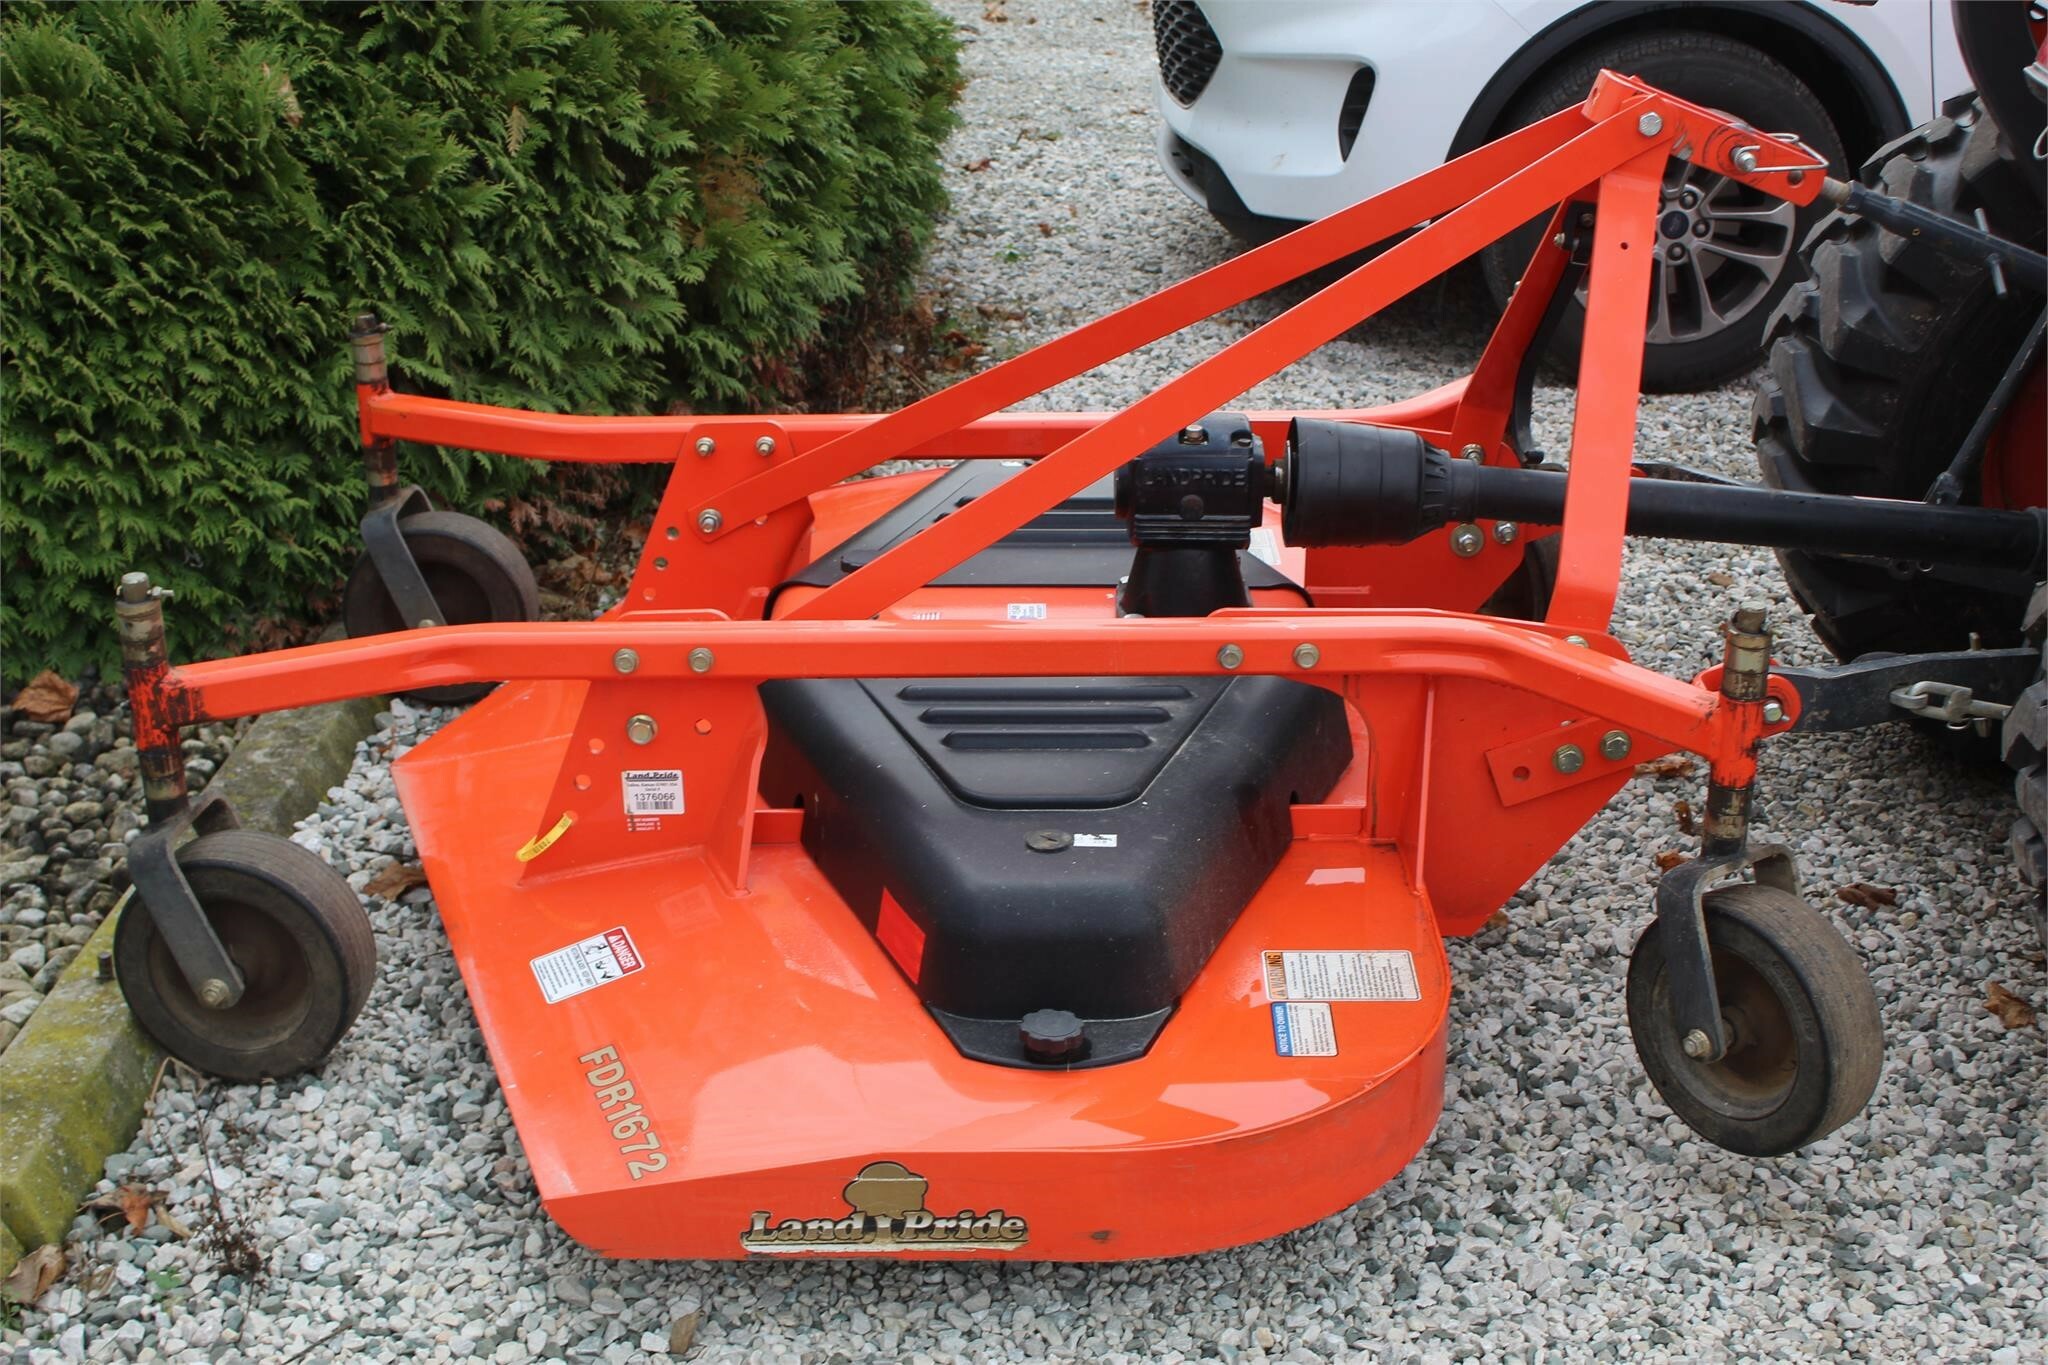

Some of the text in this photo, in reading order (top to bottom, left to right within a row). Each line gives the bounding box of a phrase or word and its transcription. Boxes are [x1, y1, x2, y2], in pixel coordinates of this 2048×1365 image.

[625, 772, 680, 780] Land Pride
[634, 793, 676, 801] 1376066
[611, 938, 637, 970] DANGER
[1267, 954, 1286, 989] WARNING
[1275, 1006, 1285, 1024] OWNER
[1279, 1033, 1288, 1053] NOTICE
[578, 1044, 669, 1181] FDR1672
[747, 1209, 1029, 1243] Land Pride
